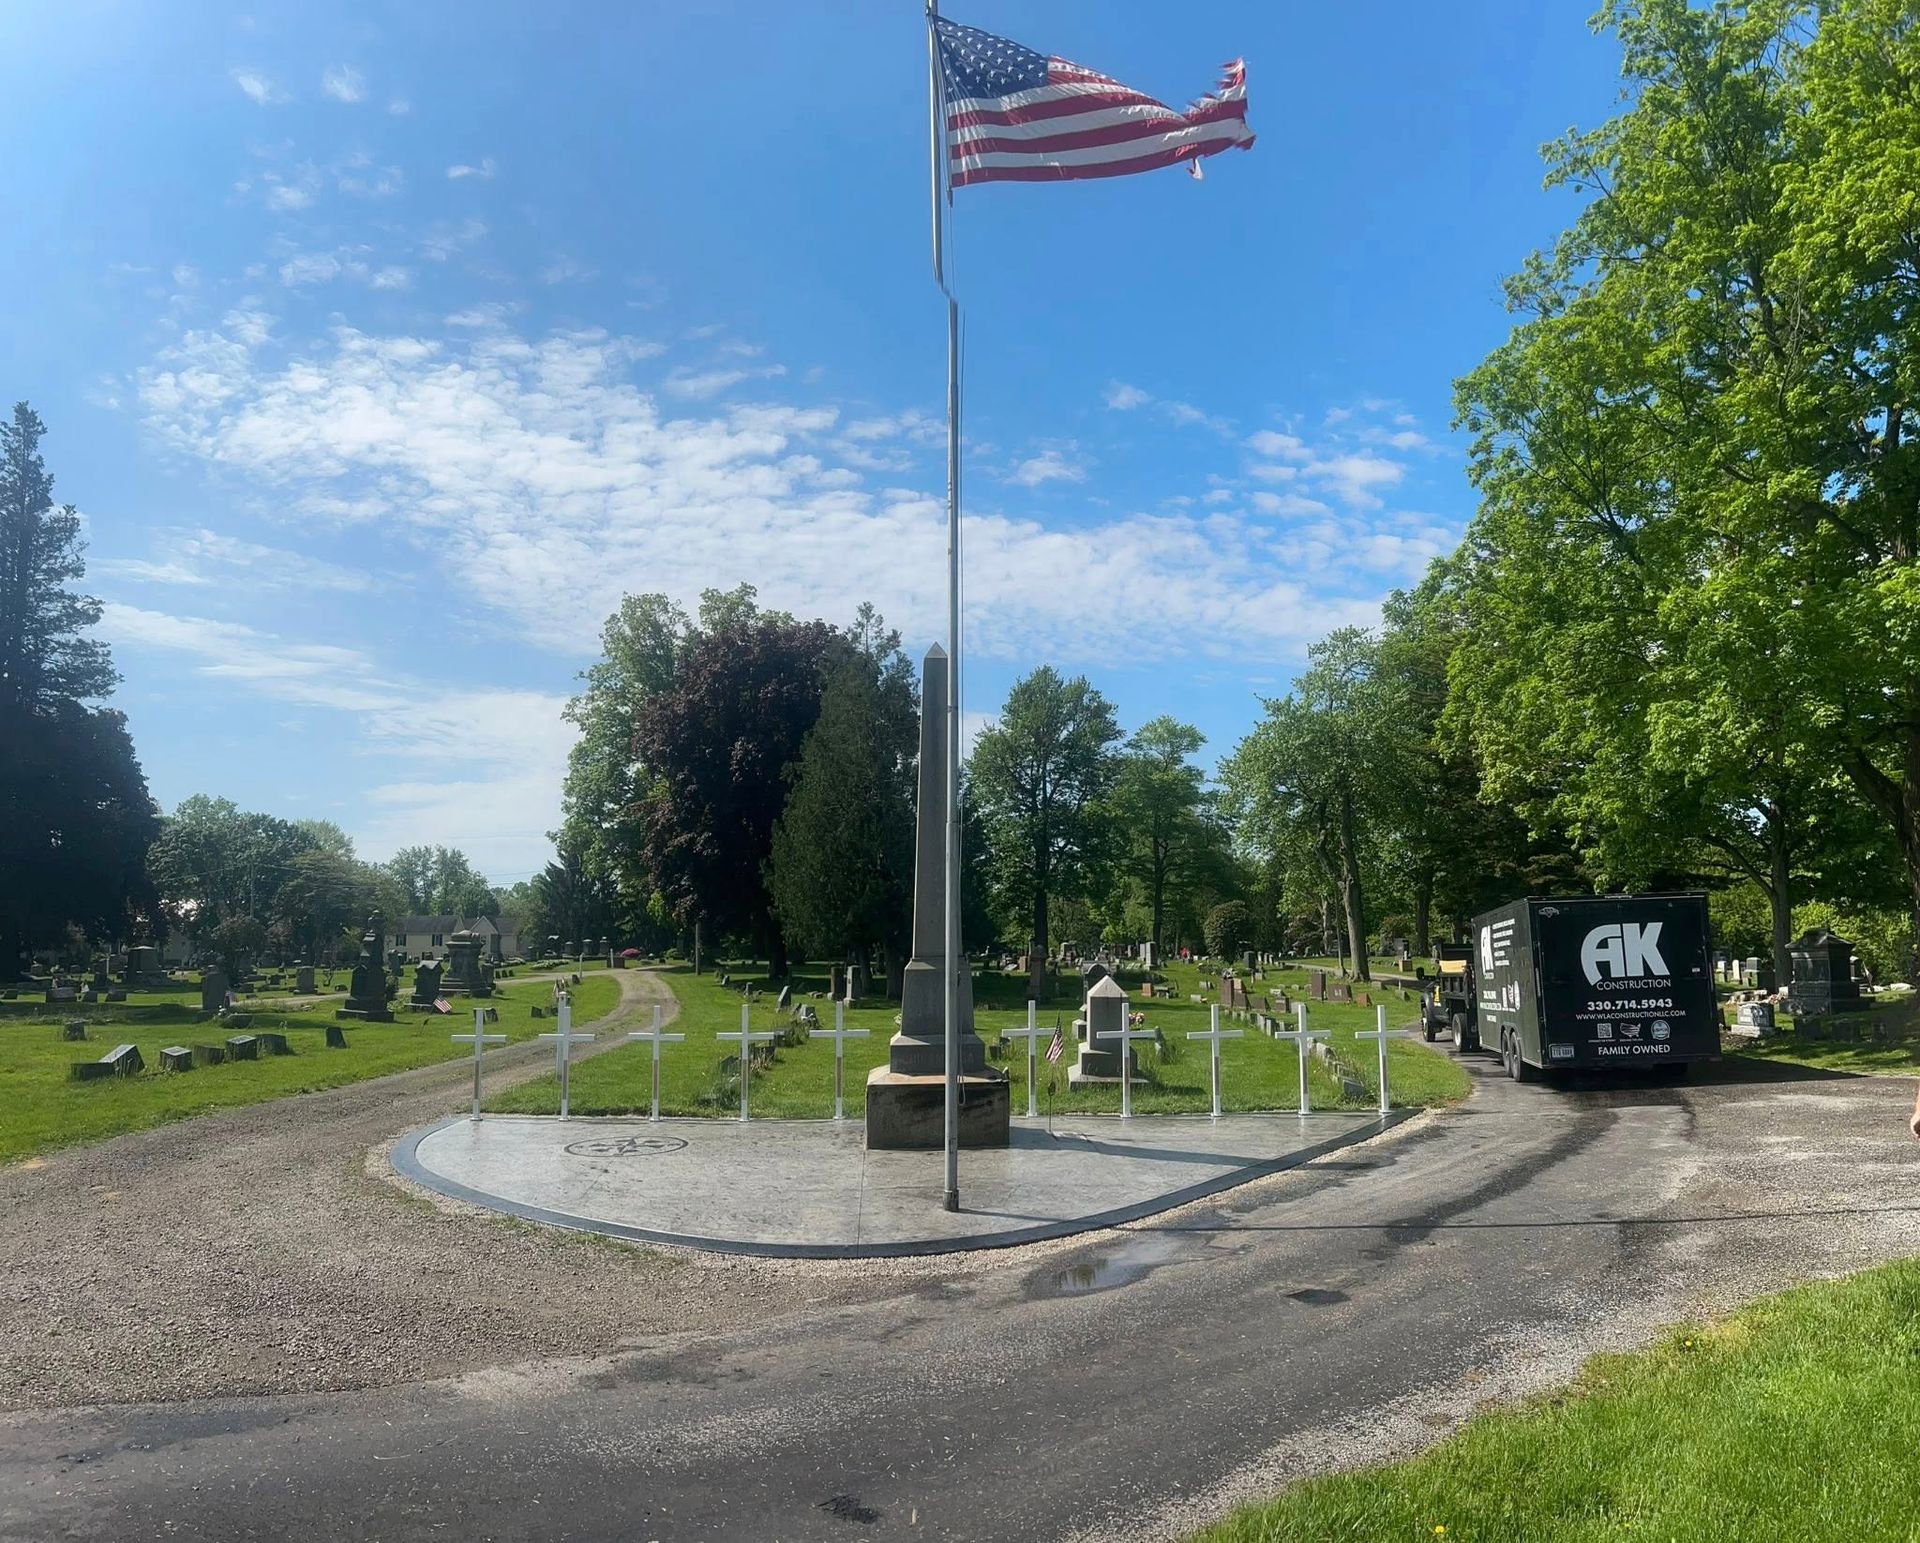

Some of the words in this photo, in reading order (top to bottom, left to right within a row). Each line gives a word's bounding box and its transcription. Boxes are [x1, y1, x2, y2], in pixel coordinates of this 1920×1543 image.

[1581, 922, 1670, 986] AK
[1596, 979, 1672, 991] CONSTRUCTION
[1587, 998, 1673, 1011] 330.714.5943
[1575, 1010, 1686, 1020] WWW.WLACONSTRUCTIONLLC.COM
[1598, 1046, 1630, 1055] FAMILY
[1632, 1044, 1671, 1054] OWNED
